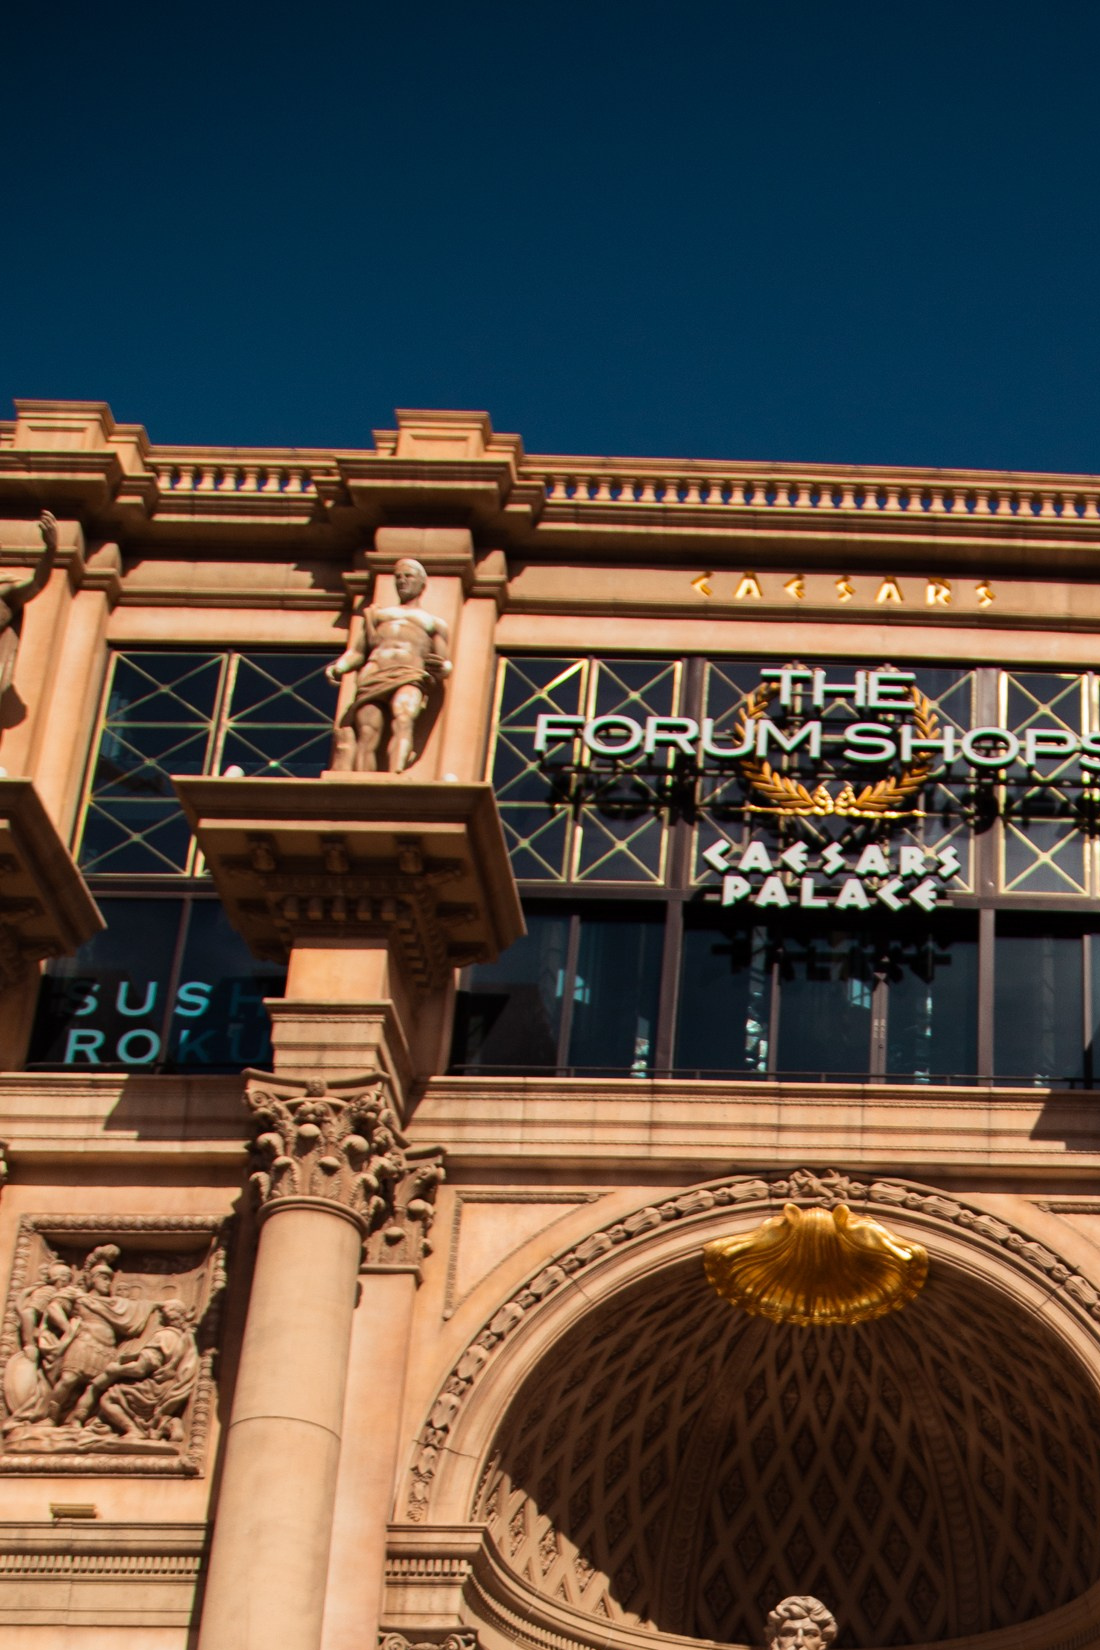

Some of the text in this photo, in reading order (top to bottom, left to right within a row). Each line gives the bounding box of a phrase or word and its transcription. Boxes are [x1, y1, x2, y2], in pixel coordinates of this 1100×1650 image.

[691, 570, 996, 608] CAESARS
[760, 668, 917, 710] THE
[533, 712, 822, 761] FORUM
[702, 839, 962, 879] CAESARS
[721, 874, 939, 912] PALACE
